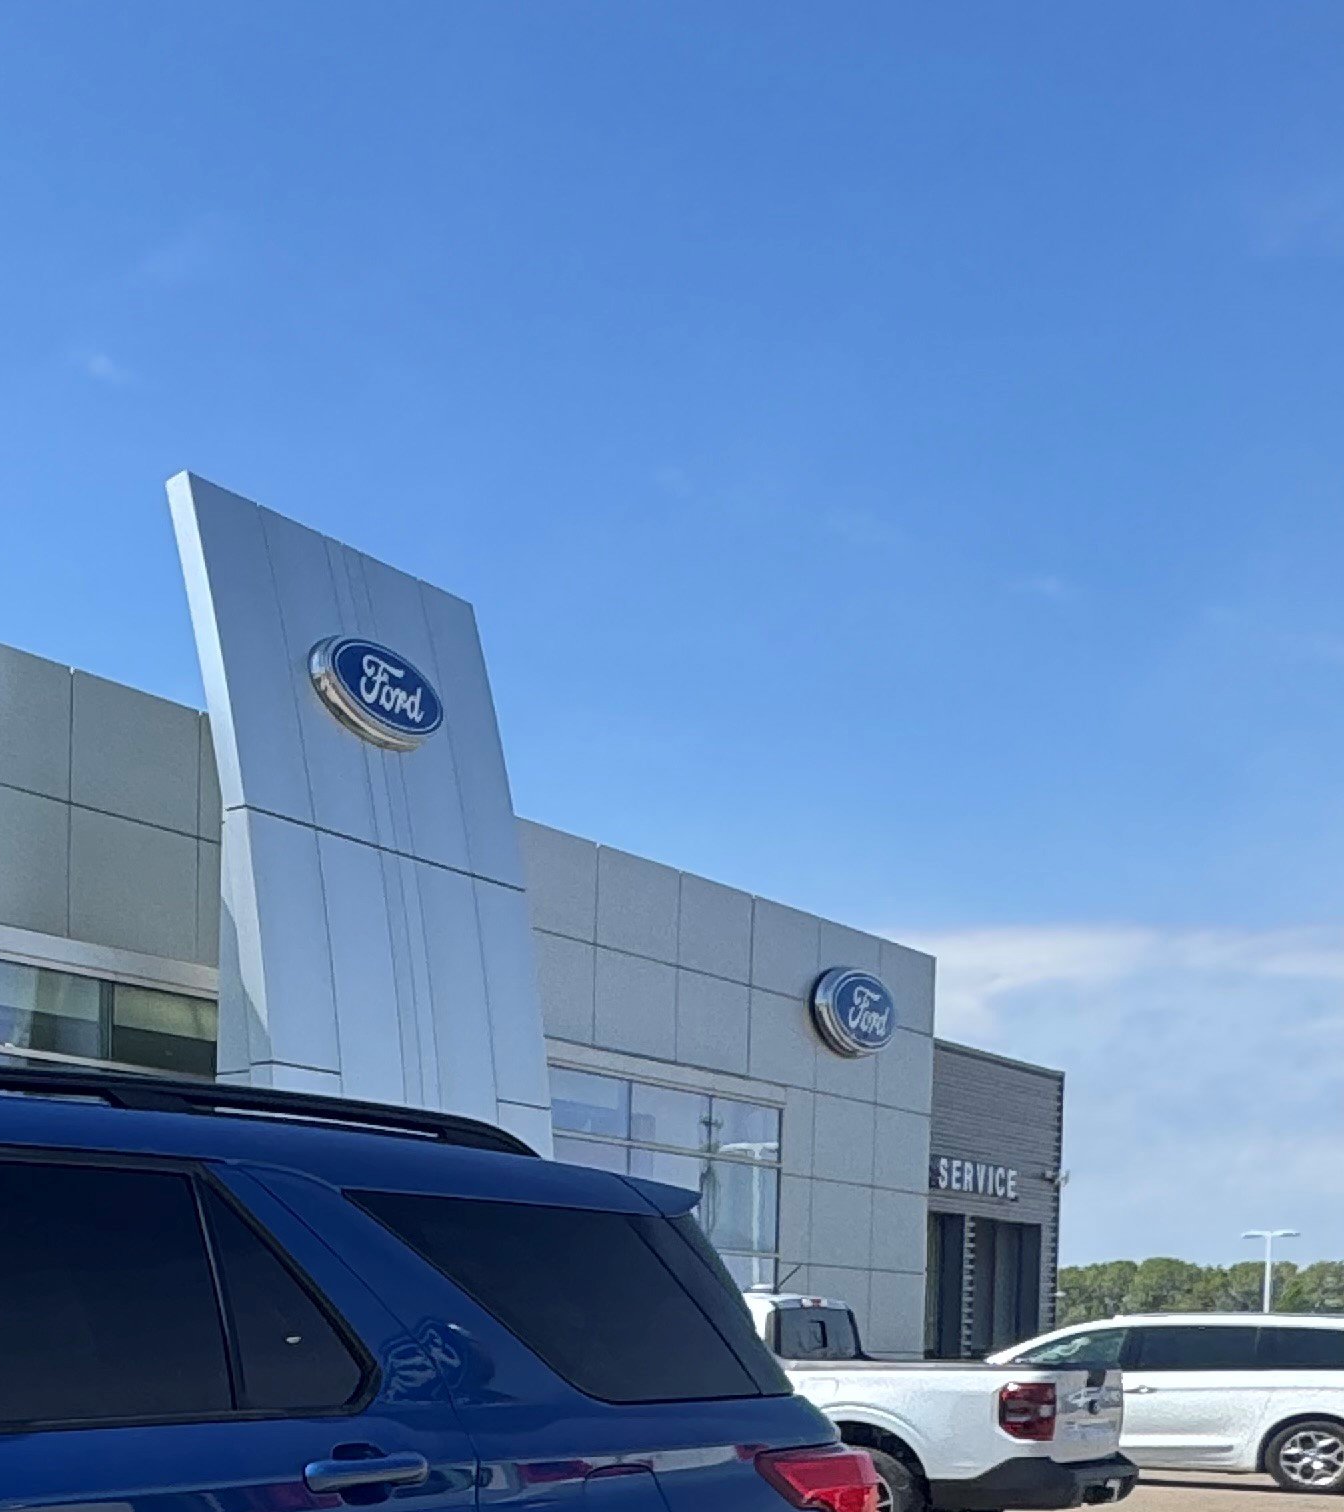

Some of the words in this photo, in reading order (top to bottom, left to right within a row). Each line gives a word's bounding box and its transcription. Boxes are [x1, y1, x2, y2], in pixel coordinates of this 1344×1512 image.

[360, 654, 426, 723] Ford
[848, 985, 890, 1036] Ford
[938, 1157, 1018, 1199] SERVICE
